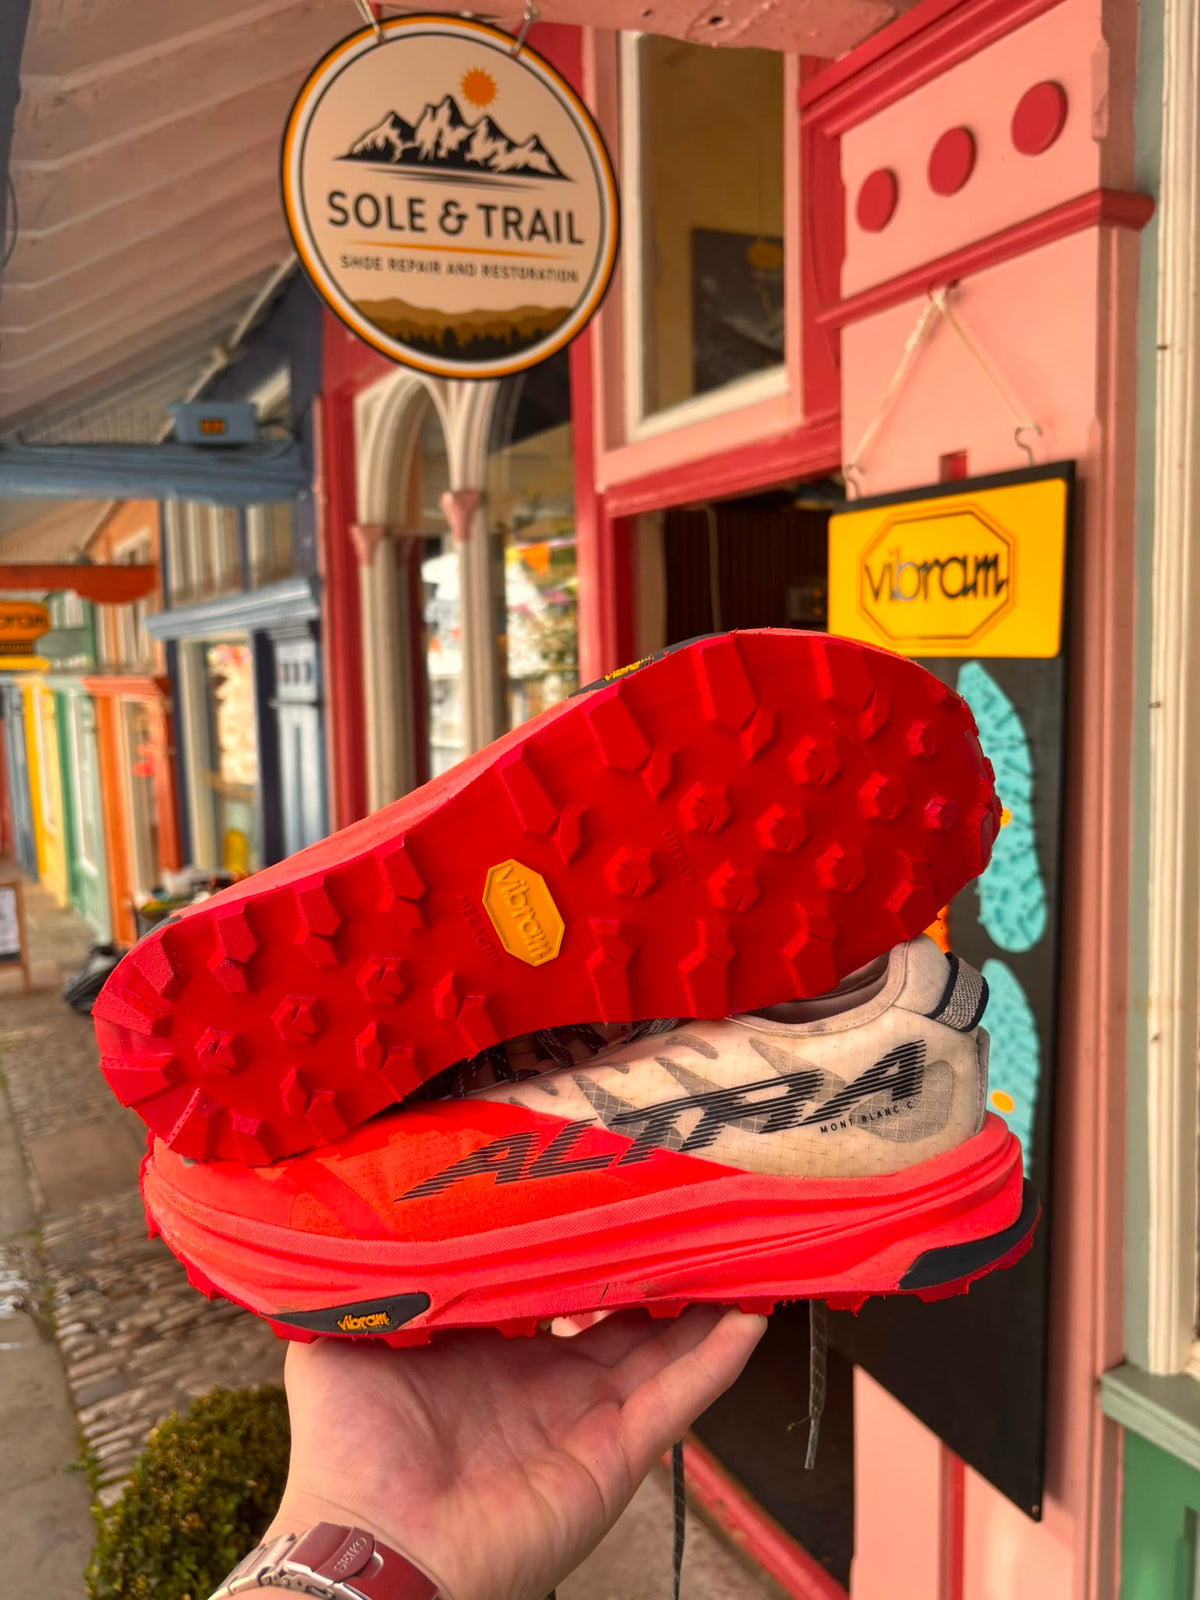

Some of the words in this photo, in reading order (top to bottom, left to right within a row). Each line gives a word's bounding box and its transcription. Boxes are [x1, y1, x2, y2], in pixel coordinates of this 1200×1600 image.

[327, 190, 427, 233] SOLE
[438, 200, 468, 236] &
[477, 203, 585, 245] TRAIL
[340, 254, 382, 272] SHOE
[388, 258, 441, 275] REPAIR
[446, 263, 477, 278] AND
[481, 264, 579, 284] RESTORATION
[864, 547, 1008, 602] vibram
[456, 894, 502, 969] MEGAGRIP
[394, 1039, 925, 1202] ALTRA
[820, 1118, 853, 1134] MONT
[861, 1105, 900, 1123] BLANC
[338, 1311, 390, 1331] vibram
